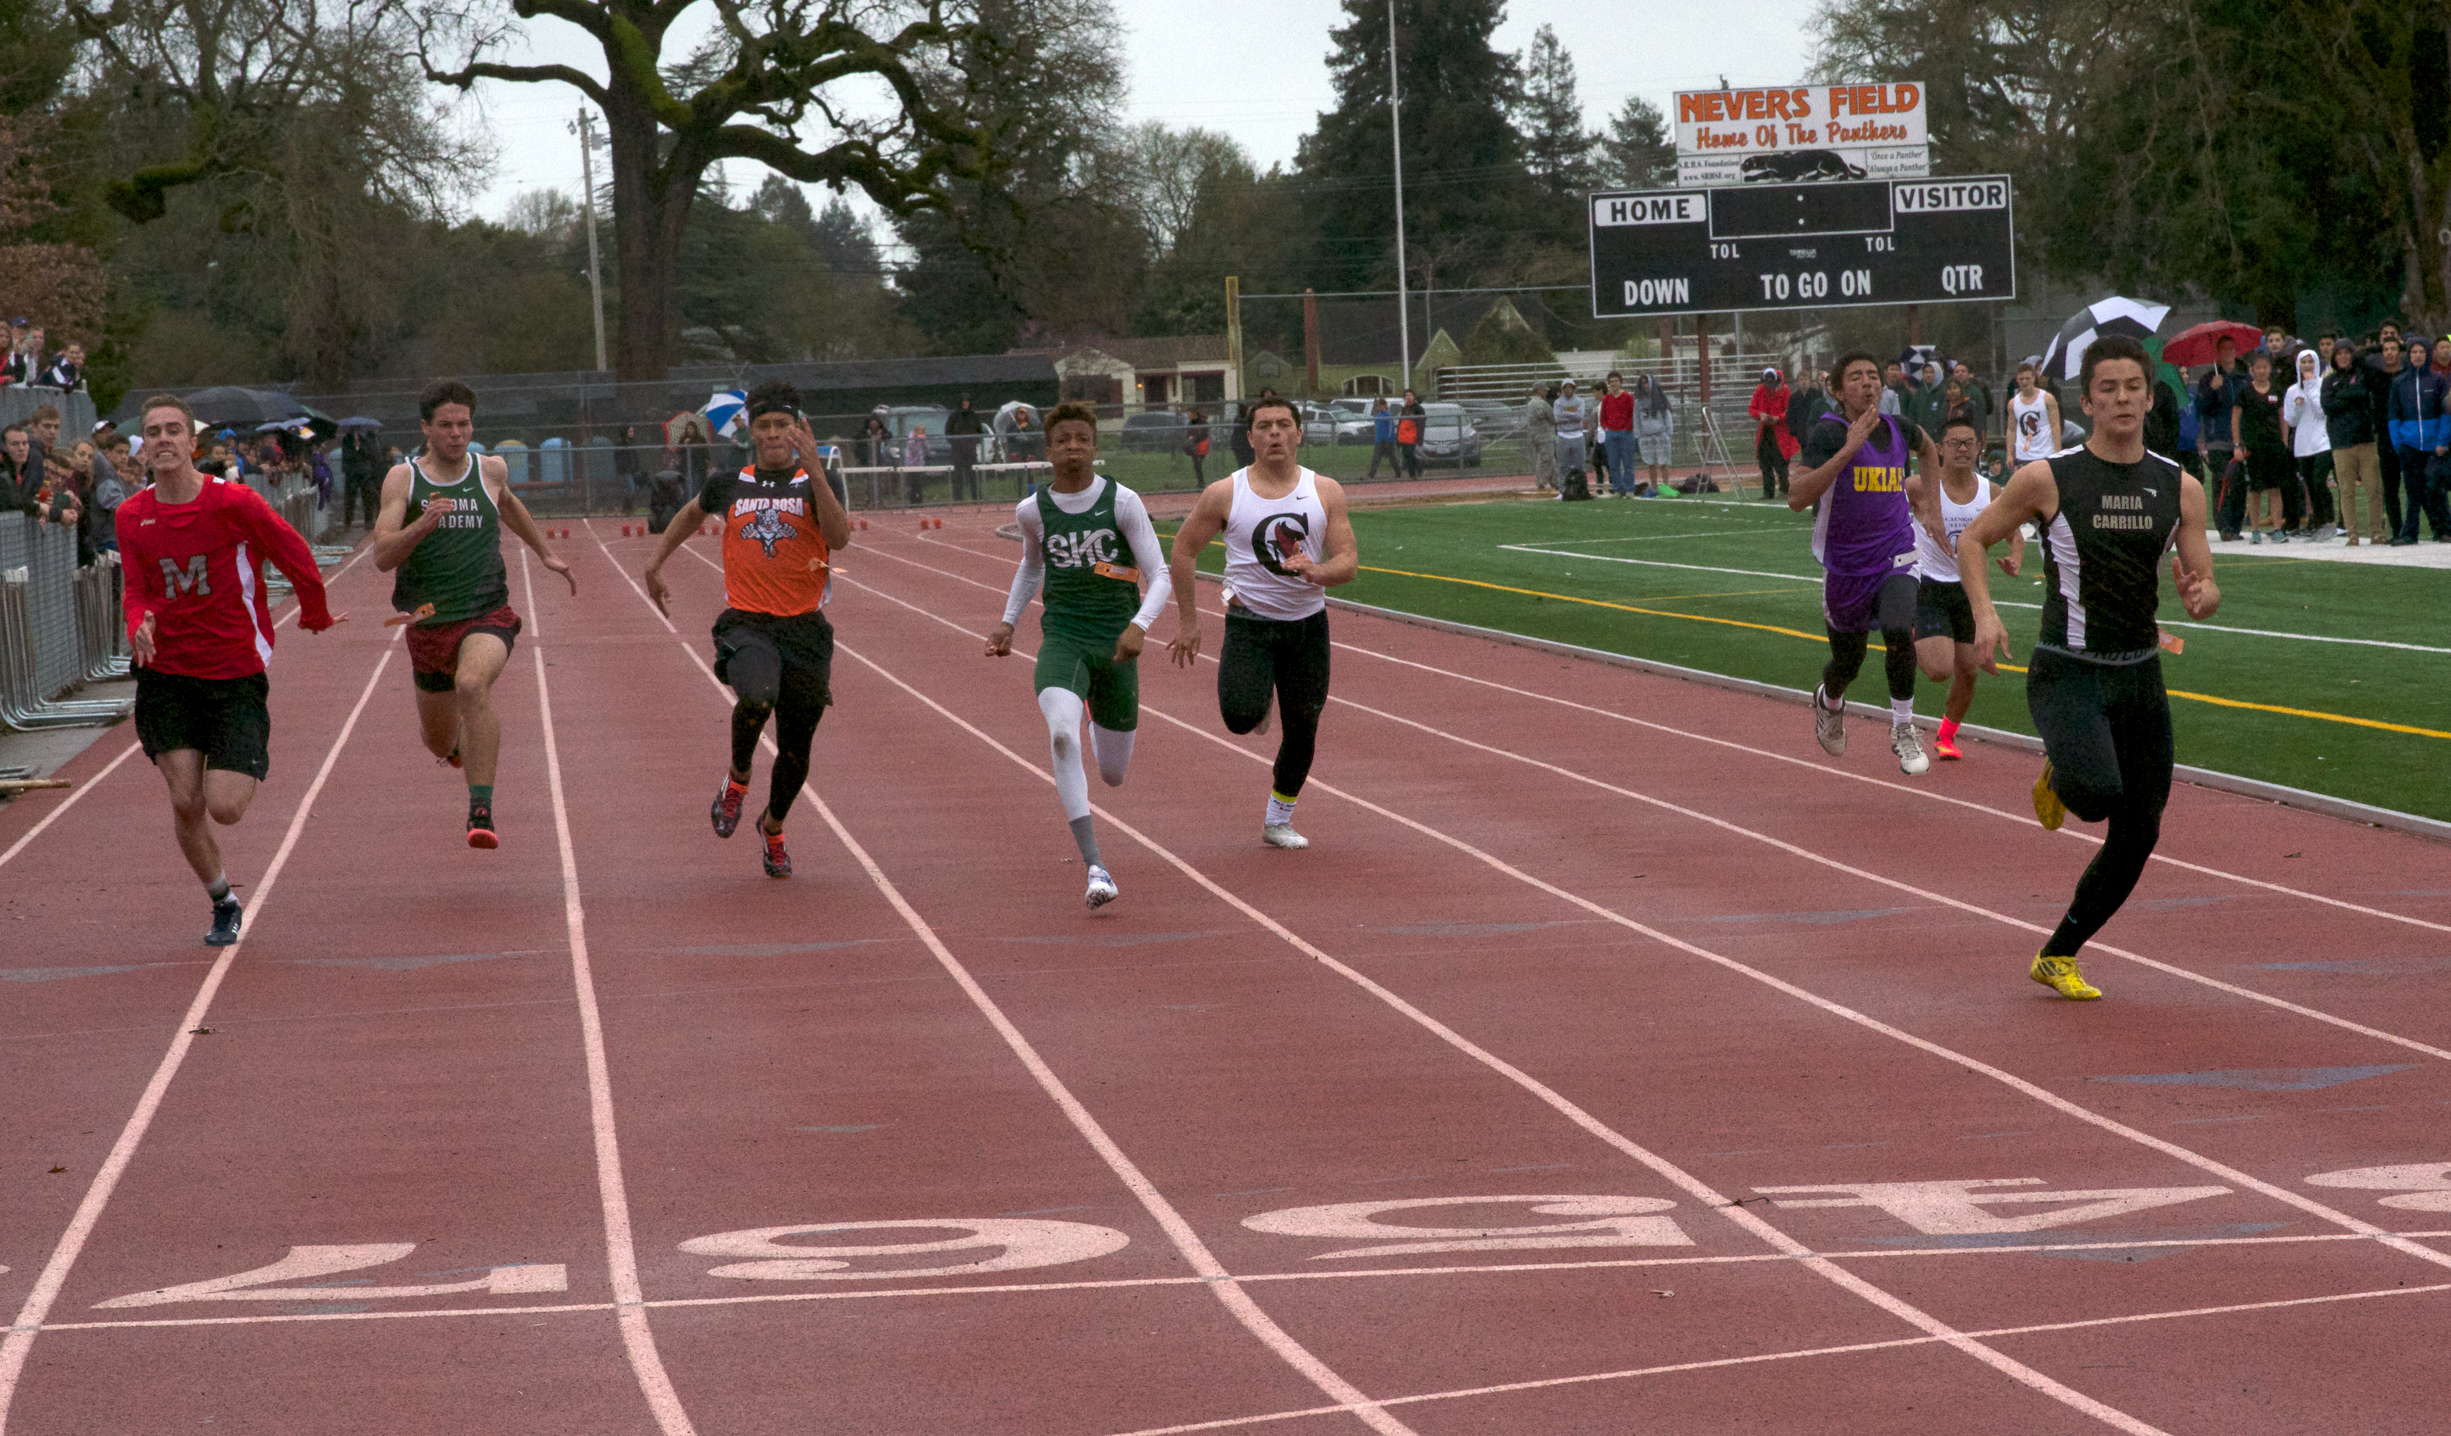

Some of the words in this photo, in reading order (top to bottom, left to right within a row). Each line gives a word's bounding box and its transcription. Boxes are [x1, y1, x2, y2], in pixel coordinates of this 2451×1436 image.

[1680, 88, 1811, 122] NEVERS
[1829, 84, 1920, 119] FIELD
[1697, 126, 1748, 149] Home
[1756, 124, 1778, 148] Of
[1786, 123, 1818, 144] The
[1825, 119, 1907, 143] Panthers
[1900, 184, 2003, 210] VISITOR
[1610, 198, 1691, 223] HOME
[1709, 244, 1740, 260] TOL
[1865, 236, 1895, 252] TOL
[1624, 278, 1690, 306] DOWN
[1760, 274, 1790, 300] TO
[1798, 271, 1828, 298] GO
[1841, 269, 1871, 297] ON
[1941, 264, 1984, 296] QTR
[420, 498, 479, 512] SOMA
[734, 497, 771, 518] SANTA
[772, 497, 804, 517] ROSA
[2101, 495, 2144, 510] MARIA
[437, 515, 483, 529] ADEMY
[2092, 514, 2153, 530] CARRILLO
[158, 554, 211, 600] M
